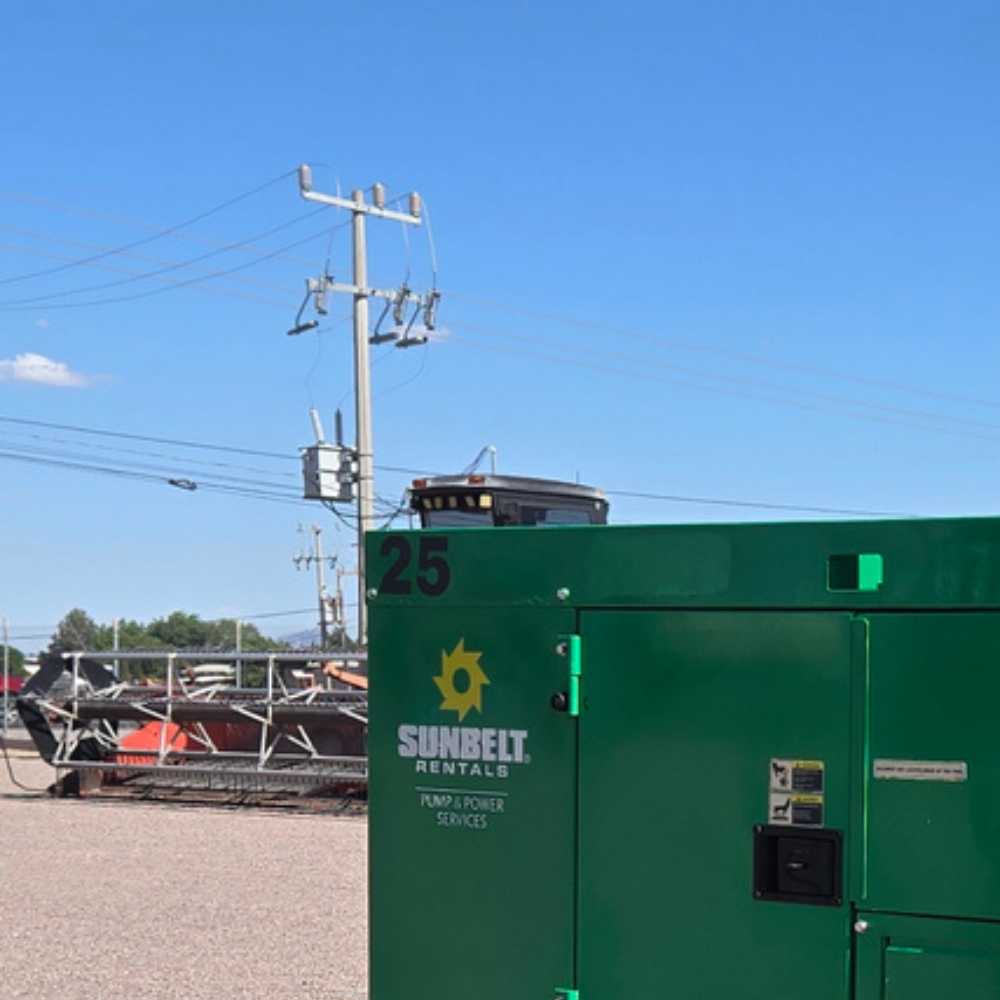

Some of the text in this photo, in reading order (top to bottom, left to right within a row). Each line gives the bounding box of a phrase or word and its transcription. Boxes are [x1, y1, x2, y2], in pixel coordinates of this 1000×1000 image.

[379, 535, 450, 597] 25
[398, 724, 528, 763] SUNBELT
[416, 760, 509, 778] RENTALS
[421, 793, 452, 808] PUMP
[437, 812, 488, 829] SERVICES
